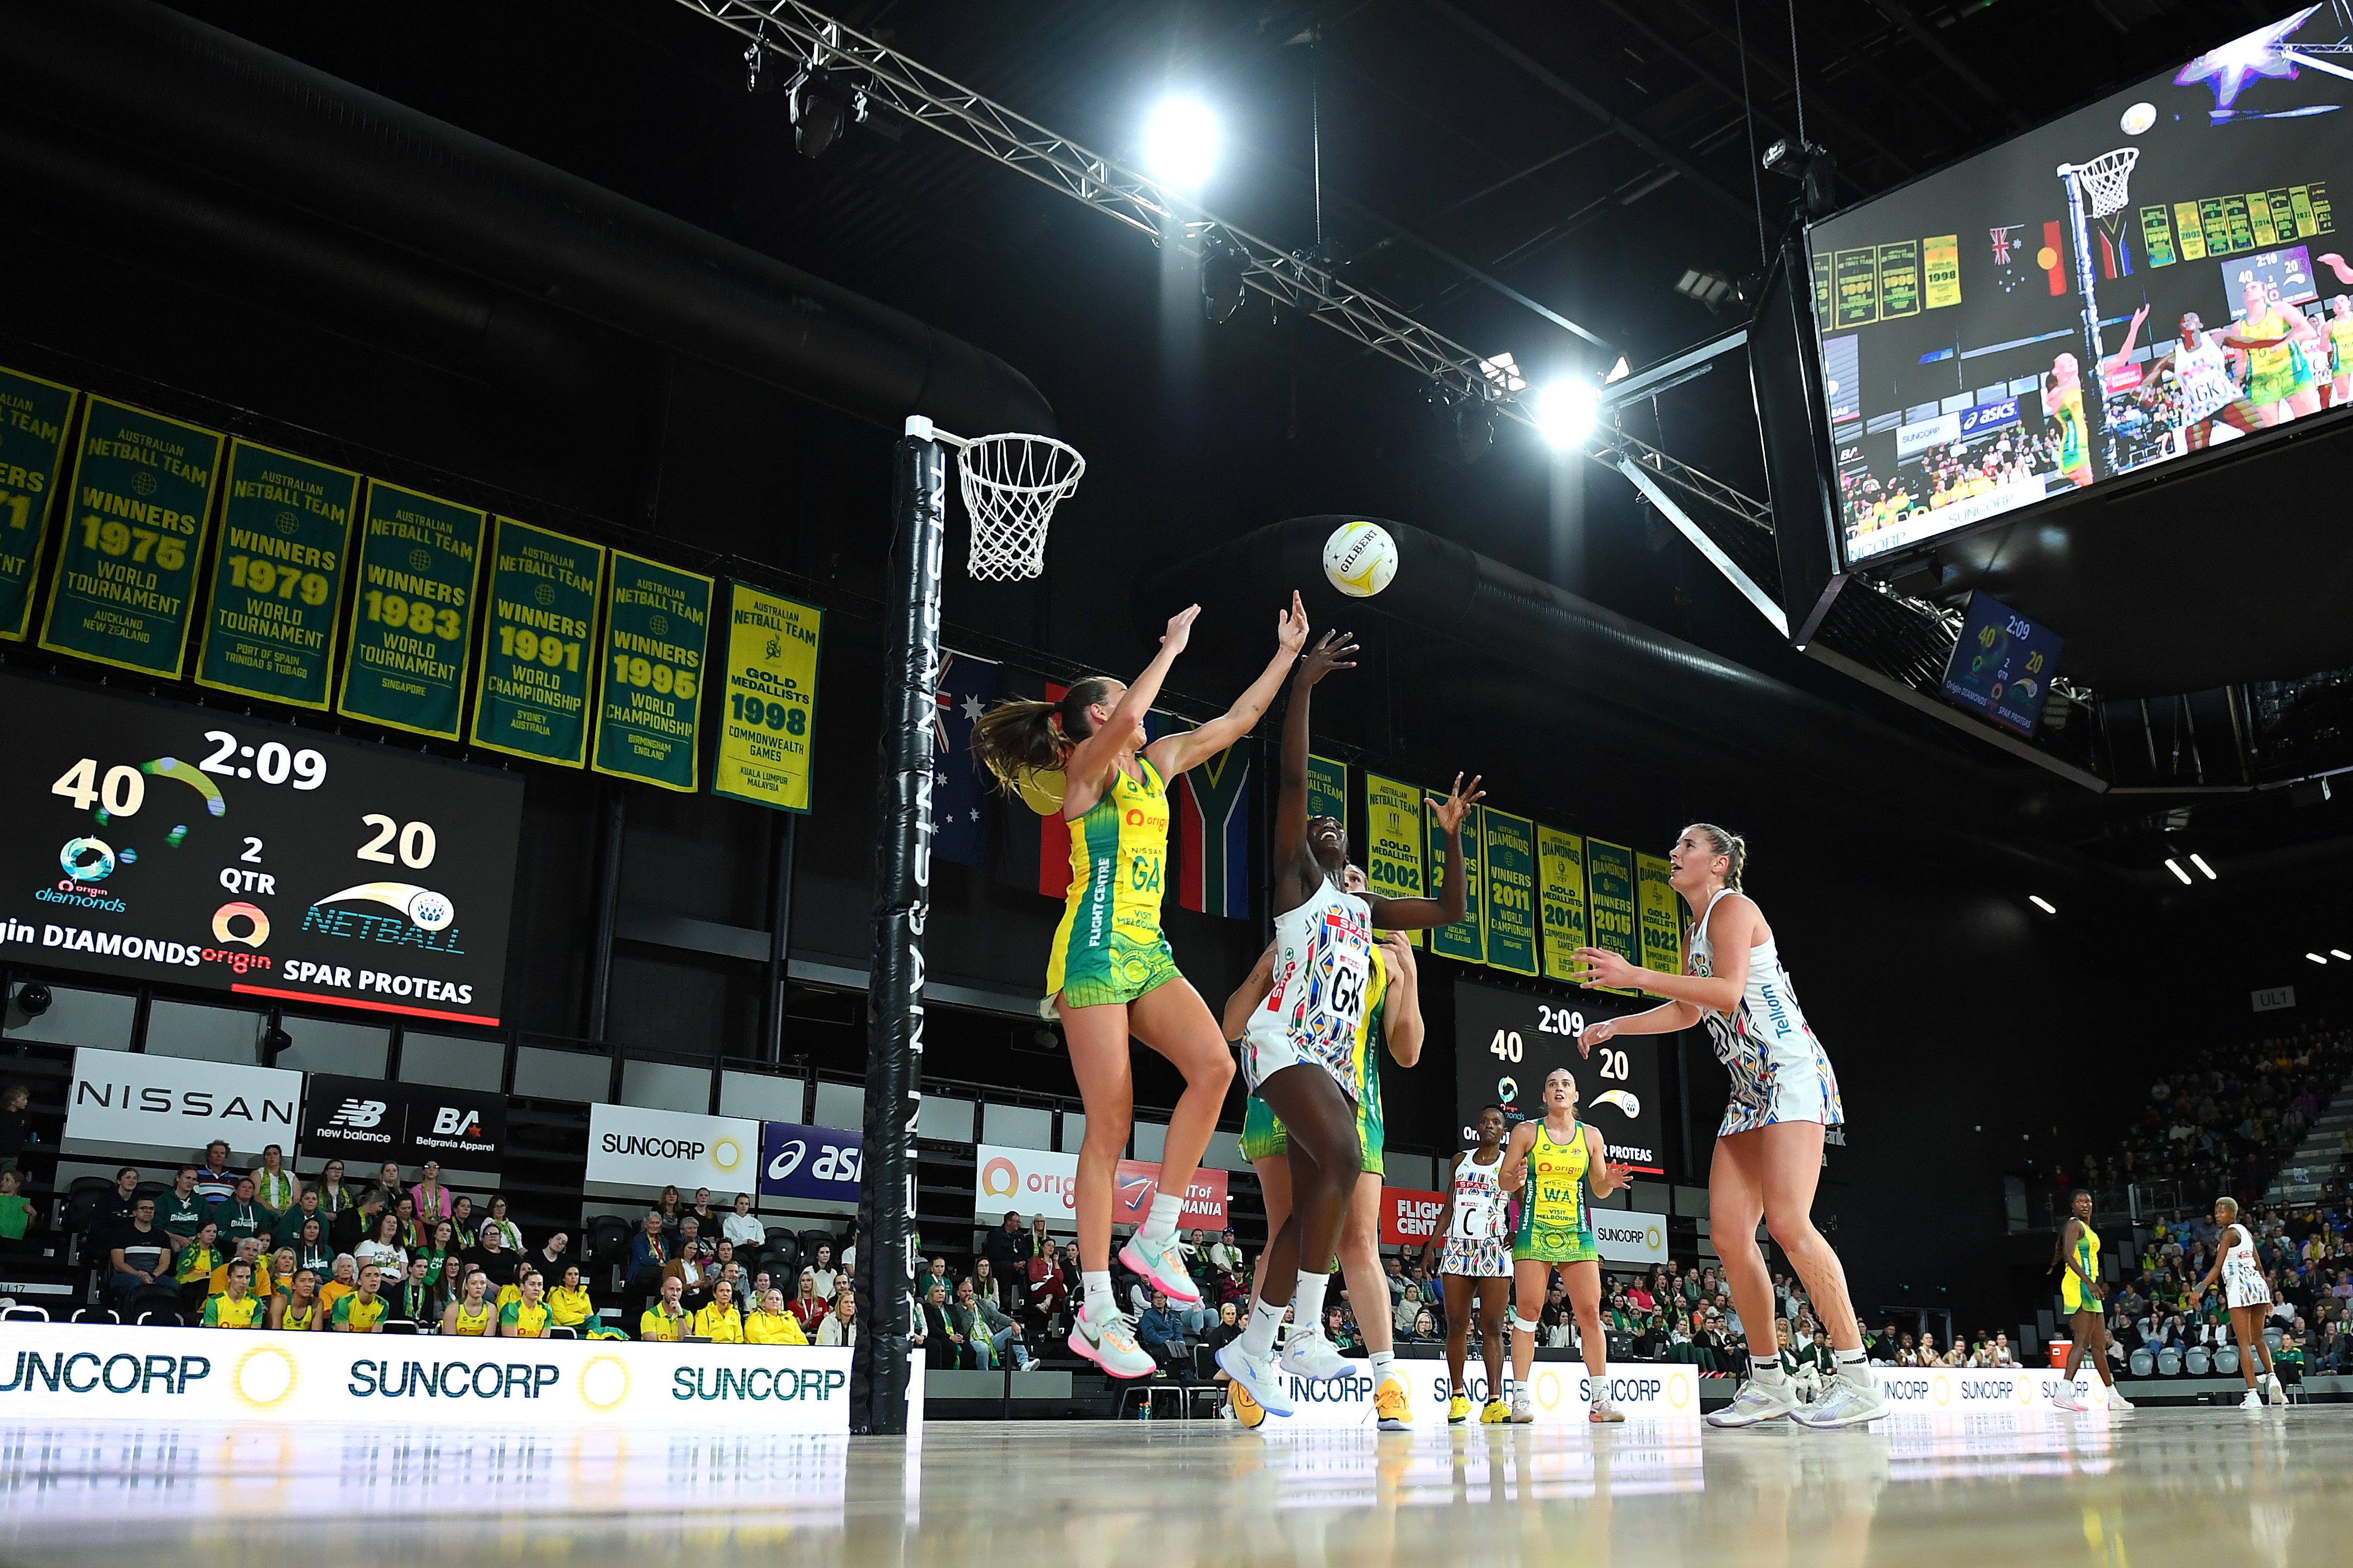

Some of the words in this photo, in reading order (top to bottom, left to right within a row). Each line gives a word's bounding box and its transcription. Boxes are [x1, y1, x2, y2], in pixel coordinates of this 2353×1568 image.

[2256, 253, 2278, 268] 2:10
[2284, 260, 2299, 275] 20
[1928, 270, 1957, 283] 1998
[2238, 270, 2253, 284] 40
[2195, 378, 2220, 402] GK
[10, 410, 58, 445] TEAM
[1902, 427, 1940, 444] SUNCORP
[118, 428, 184, 457] AUSTRALIAN
[88, 437, 158, 467] NETBALL
[164, 456, 208, 488] TEAM
[261, 470, 323, 496] AUSTRALIAN
[82, 486, 196, 535] WINNERS
[234, 479, 299, 507] NETBALL
[305, 496, 346, 526] TEAM
[1948, 493, 2014, 526] SUNCORP
[395, 509, 453, 534] AUSTRALIAN
[80, 514, 187, 571] 1975
[230, 526, 336, 572] WINNERS
[370, 518, 432, 545] NETBALL
[435, 532, 473, 563] TEAM
[1340, 529, 1378, 573] GILBERT
[522, 545, 575, 569] AUSTRALIAN
[97, 560, 158, 591] WORLD
[228, 554, 329, 606] 1979
[368, 563, 466, 607] WINNERS
[499, 554, 556, 580] NETBALL
[559, 568, 594, 597] TEAM
[68, 570, 181, 616] TOURNAMENT
[636, 578, 686, 601] AUSTRALIAN
[94, 610, 144, 630] AUCKLAND
[246, 597, 303, 626] WORLD
[364, 589, 462, 642] 1983
[498, 597, 587, 640] WINNERS
[615, 587, 669, 612] NETBALL
[671, 600, 704, 628] TEAM
[753, 600, 799, 623] AUSTRALIAN
[83, 618, 107, 633] NEW
[108, 624, 151, 644] ZEALAND
[219, 608, 324, 649] TOURNAMENT
[734, 609, 783, 633] NETBALL
[785, 620, 817, 648] TEAM
[1978, 625, 1997, 649] 40
[2005, 615, 2030, 641] 2:09
[236, 643, 259, 656] PORT
[262, 648, 272, 658] OF
[274, 651, 300, 666] SPAIN
[383, 631, 436, 659] WORLD
[499, 624, 581, 673] 1991
[614, 629, 699, 669] WINNERS
[225, 651, 264, 669] TRINIDAD
[275, 662, 308, 679] TOBAGO
[360, 643, 457, 682] TOURNAMENT
[2003, 657, 2011, 669] 2
[2025, 651, 2044, 674] 20
[381, 677, 427, 697] SINGAPORE
[512, 664, 561, 691] WORLD
[613, 654, 696, 701] 1995
[731, 674, 810, 705] MEDALLISTS
[745, 667, 798, 690] GOLD
[487, 675, 582, 713] CHAMPIONSHIP
[631, 691, 675, 718] WORLD
[517, 709, 547, 725] SYDNEY
[605, 703, 693, 739] CHAMPIONSHIP
[730, 691, 807, 737] 1998
[1997, 705, 2011, 717] SPAR
[510, 718, 551, 737] AUSTRALIA
[728, 724, 805, 756] COMMONWEALTH
[628, 733, 672, 754] BIRMINGHAM
[633, 743, 665, 762] ENGLAND
[749, 744, 782, 763] GAMES
[198, 730, 328, 791] 2:09
[51, 757, 146, 818] 40
[740, 766, 761, 779] KUALA
[762, 771, 788, 786] LUMPUR
[747, 777, 780, 793] MALAYSIA
[1322, 782, 1344, 802] TEAM
[1379, 785, 1408, 799] AUSTRALIAN
[1370, 793, 1398, 809] NETBALL
[1399, 800, 1419, 819] TEAM
[240, 836, 264, 864] 2
[356, 813, 436, 870] 20
[1131, 847, 1163, 855] NISSAN
[1371, 845, 1419, 865] MEDALLISTS
[1379, 838, 1411, 853] GOLD
[1488, 829, 1529, 857] DIAMONDS
[1542, 841, 1580, 866] DIAMONDS
[219, 867, 276, 896] QTR
[1093, 857, 1110, 903] CENTRE
[1132, 855, 1160, 894] GA
[1371, 858, 1420, 891] 2002
[1592, 859, 1628, 883] DIAMONDS
[35, 887, 127, 913] diamonds
[75, 885, 108, 898] origin
[1492, 882, 1530, 912] 2011
[1543, 891, 1583, 907] MEDALLISTS
[1549, 884, 1575, 898] GOLD
[1593, 893, 1631, 913] WINNERS
[1088, 904, 1104, 947] FLIGHT
[1134, 910, 1152, 920] VISIT
[1500, 909, 1523, 925] WORLD
[1544, 904, 1583, 931] 2014
[1594, 909, 1631, 936] 2015
[1643, 914, 1677, 930] MEDALLISTS
[1647, 907, 1671, 920] GOLD
[301, 905, 465, 955] NETBALL
[1339, 918, 1371, 942] SPAR
[1602, 933, 1627, 949] NETBALL
[1644, 927, 1678, 953] 2022
[42, 924, 202, 968] DIAMONDS
[1557, 940, 1574, 951] GAMES
[200, 947, 272, 975] origin
[282, 959, 352, 990] SPAR
[357, 969, 474, 1005] PROTEAS
[1331, 966, 1365, 1022] GK
[1760, 984, 1793, 1040] Telkom
[2259, 991, 2287, 1007] UL1
[1537, 1004, 1585, 1038] 2:09
[1490, 1029, 1523, 1063] 40
[1599, 1048, 1629, 1081] 20
[76, 1080, 295, 1126] NISSAN
[316, 1127, 341, 1139] new
[343, 1128, 392, 1144] balance
[415, 1136, 458, 1151] Belgravia
[459, 1140, 495, 1152] Apparel
[601, 1133, 705, 1161] SUNCORP
[1609, 1144, 1653, 1163] PROTEAS
[1555, 1166, 1582, 1175] origin
[1198, 1186, 1213, 1199] of
[1459, 1181, 1489, 1191] SPAR
[1543, 1187, 1573, 1204] WA
[1463, 1207, 1477, 1236] C
[1522, 1204, 1531, 1231] FLIGHT
[1536, 1214, 1577, 1222] MELBOURNE
[1598, 1227, 1645, 1244] SUNCORP
[347, 1359, 560, 1399] SUNCORP
[671, 1366, 845, 1401] SUNCORP
[1961, 1380, 2013, 1400] SUNCORP
